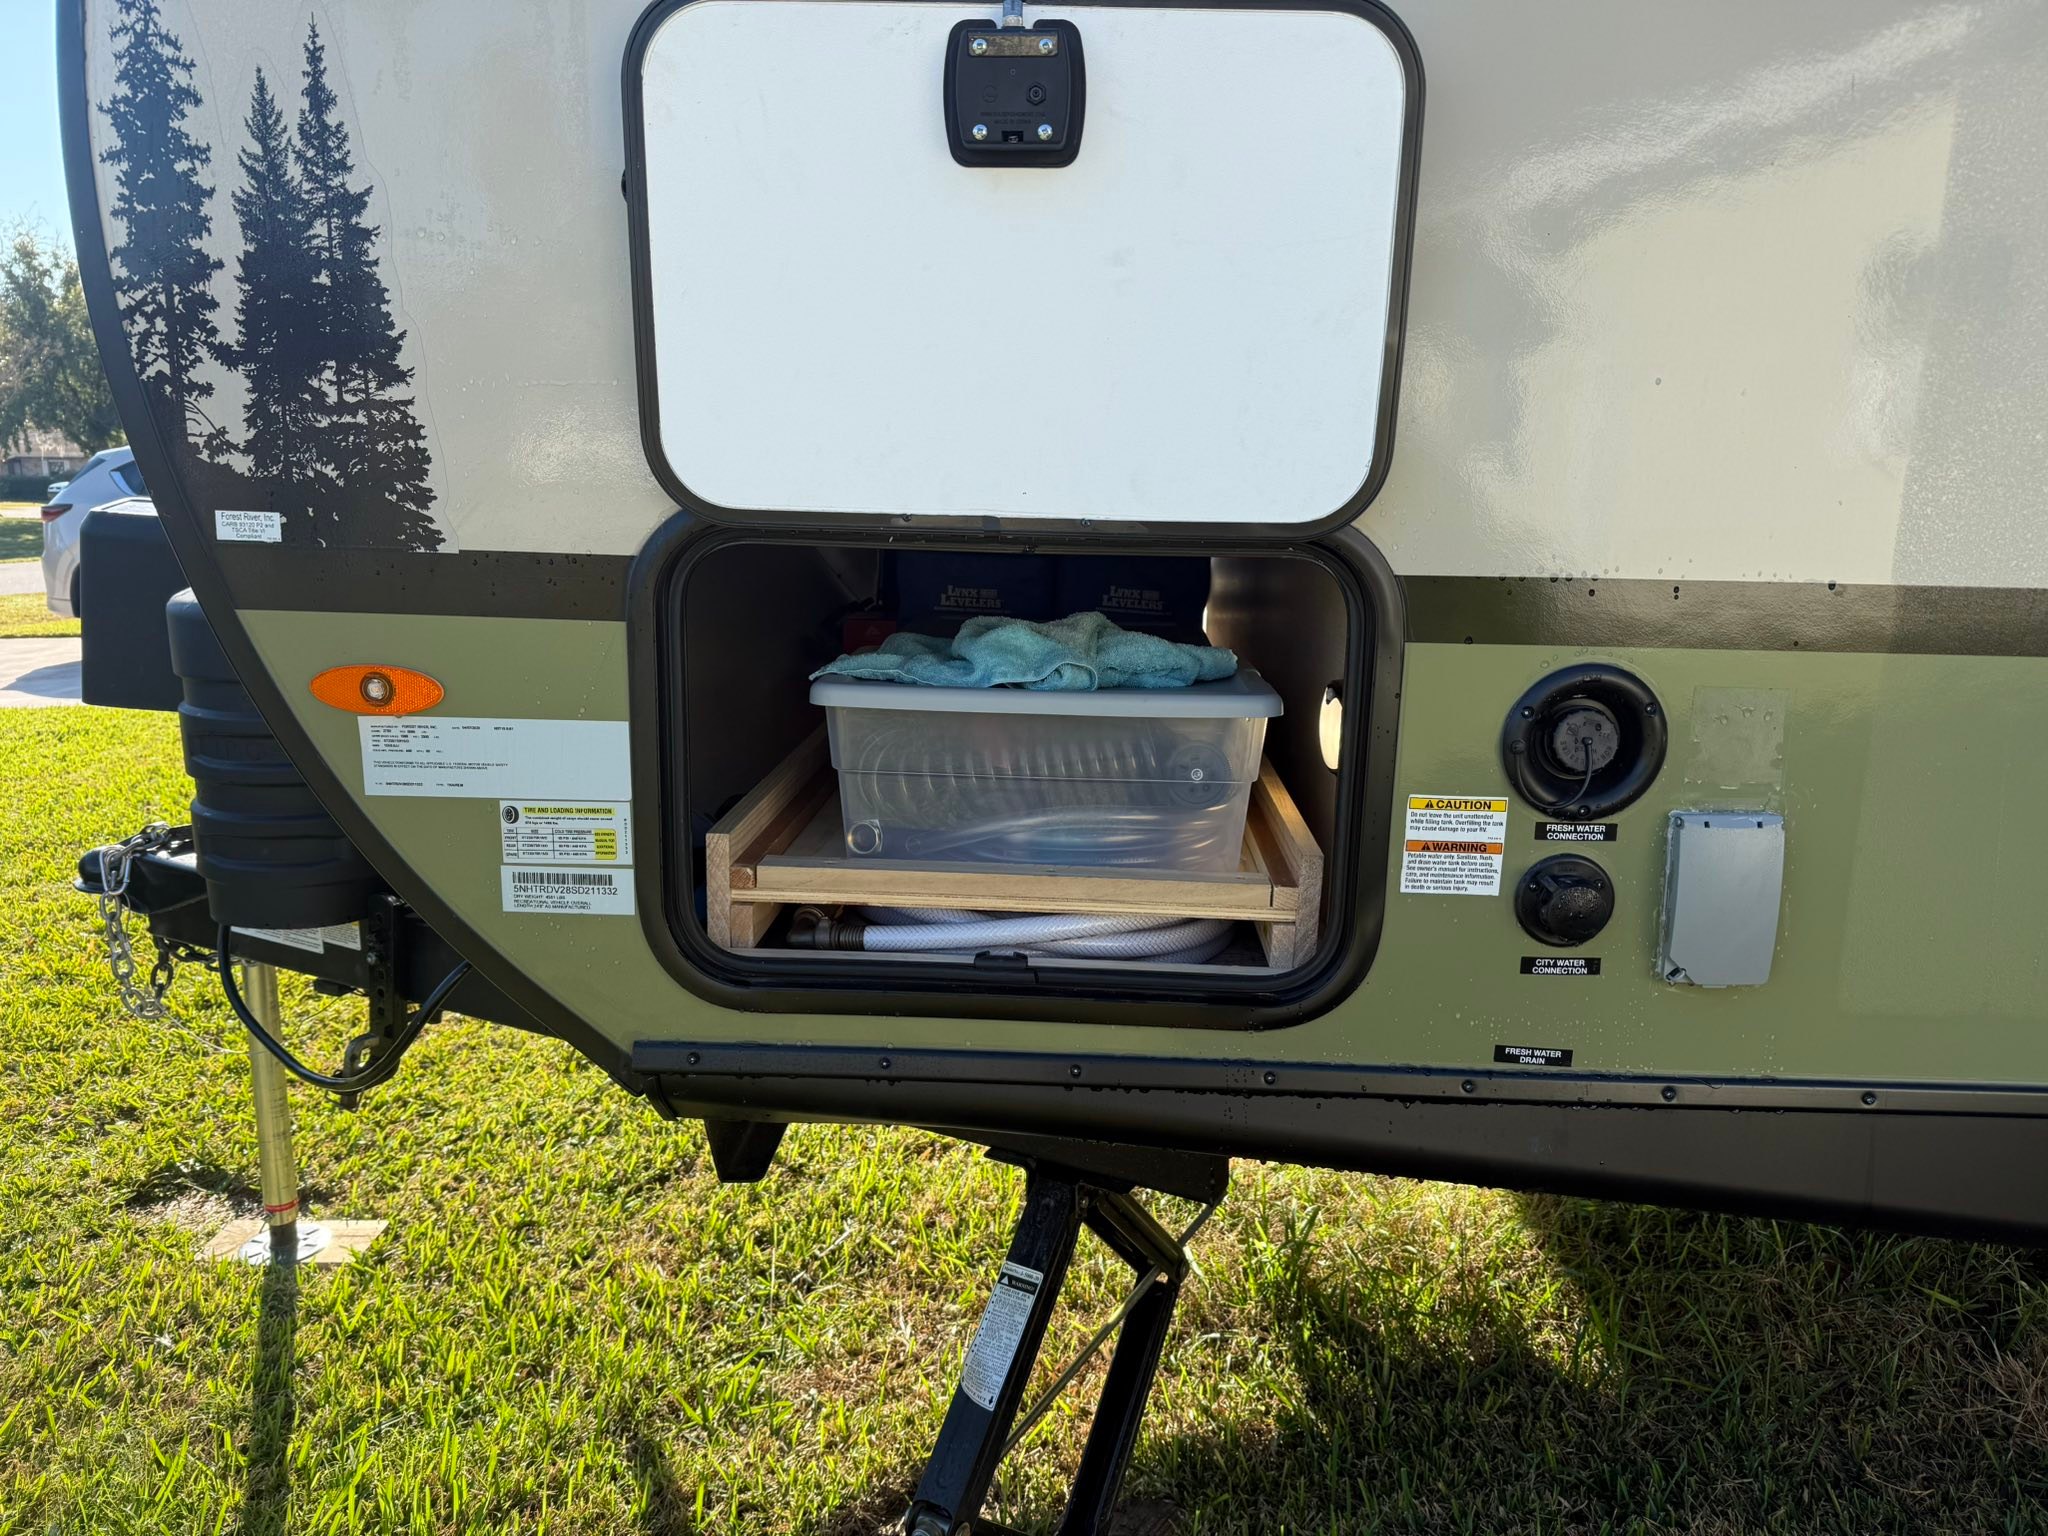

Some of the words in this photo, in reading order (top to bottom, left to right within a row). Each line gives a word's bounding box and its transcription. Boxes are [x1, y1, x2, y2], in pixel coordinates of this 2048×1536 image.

[221, 512, 242, 521] Forest
[264, 514, 275, 522] Inc.
[1436, 800, 1492, 810] CAUTION
[1576, 825, 1606, 833] WATER
[1546, 832, 1604, 841] CONNECTION
[1433, 843, 1488, 853] WARNING
[513, 885, 618, 896] 5NHTRDV28SD211332
[1505, 1047, 1533, 1056] FRESH
[1534, 1050, 1562, 1058] WATER
[1519, 1056, 1546, 1065] DRAIN
